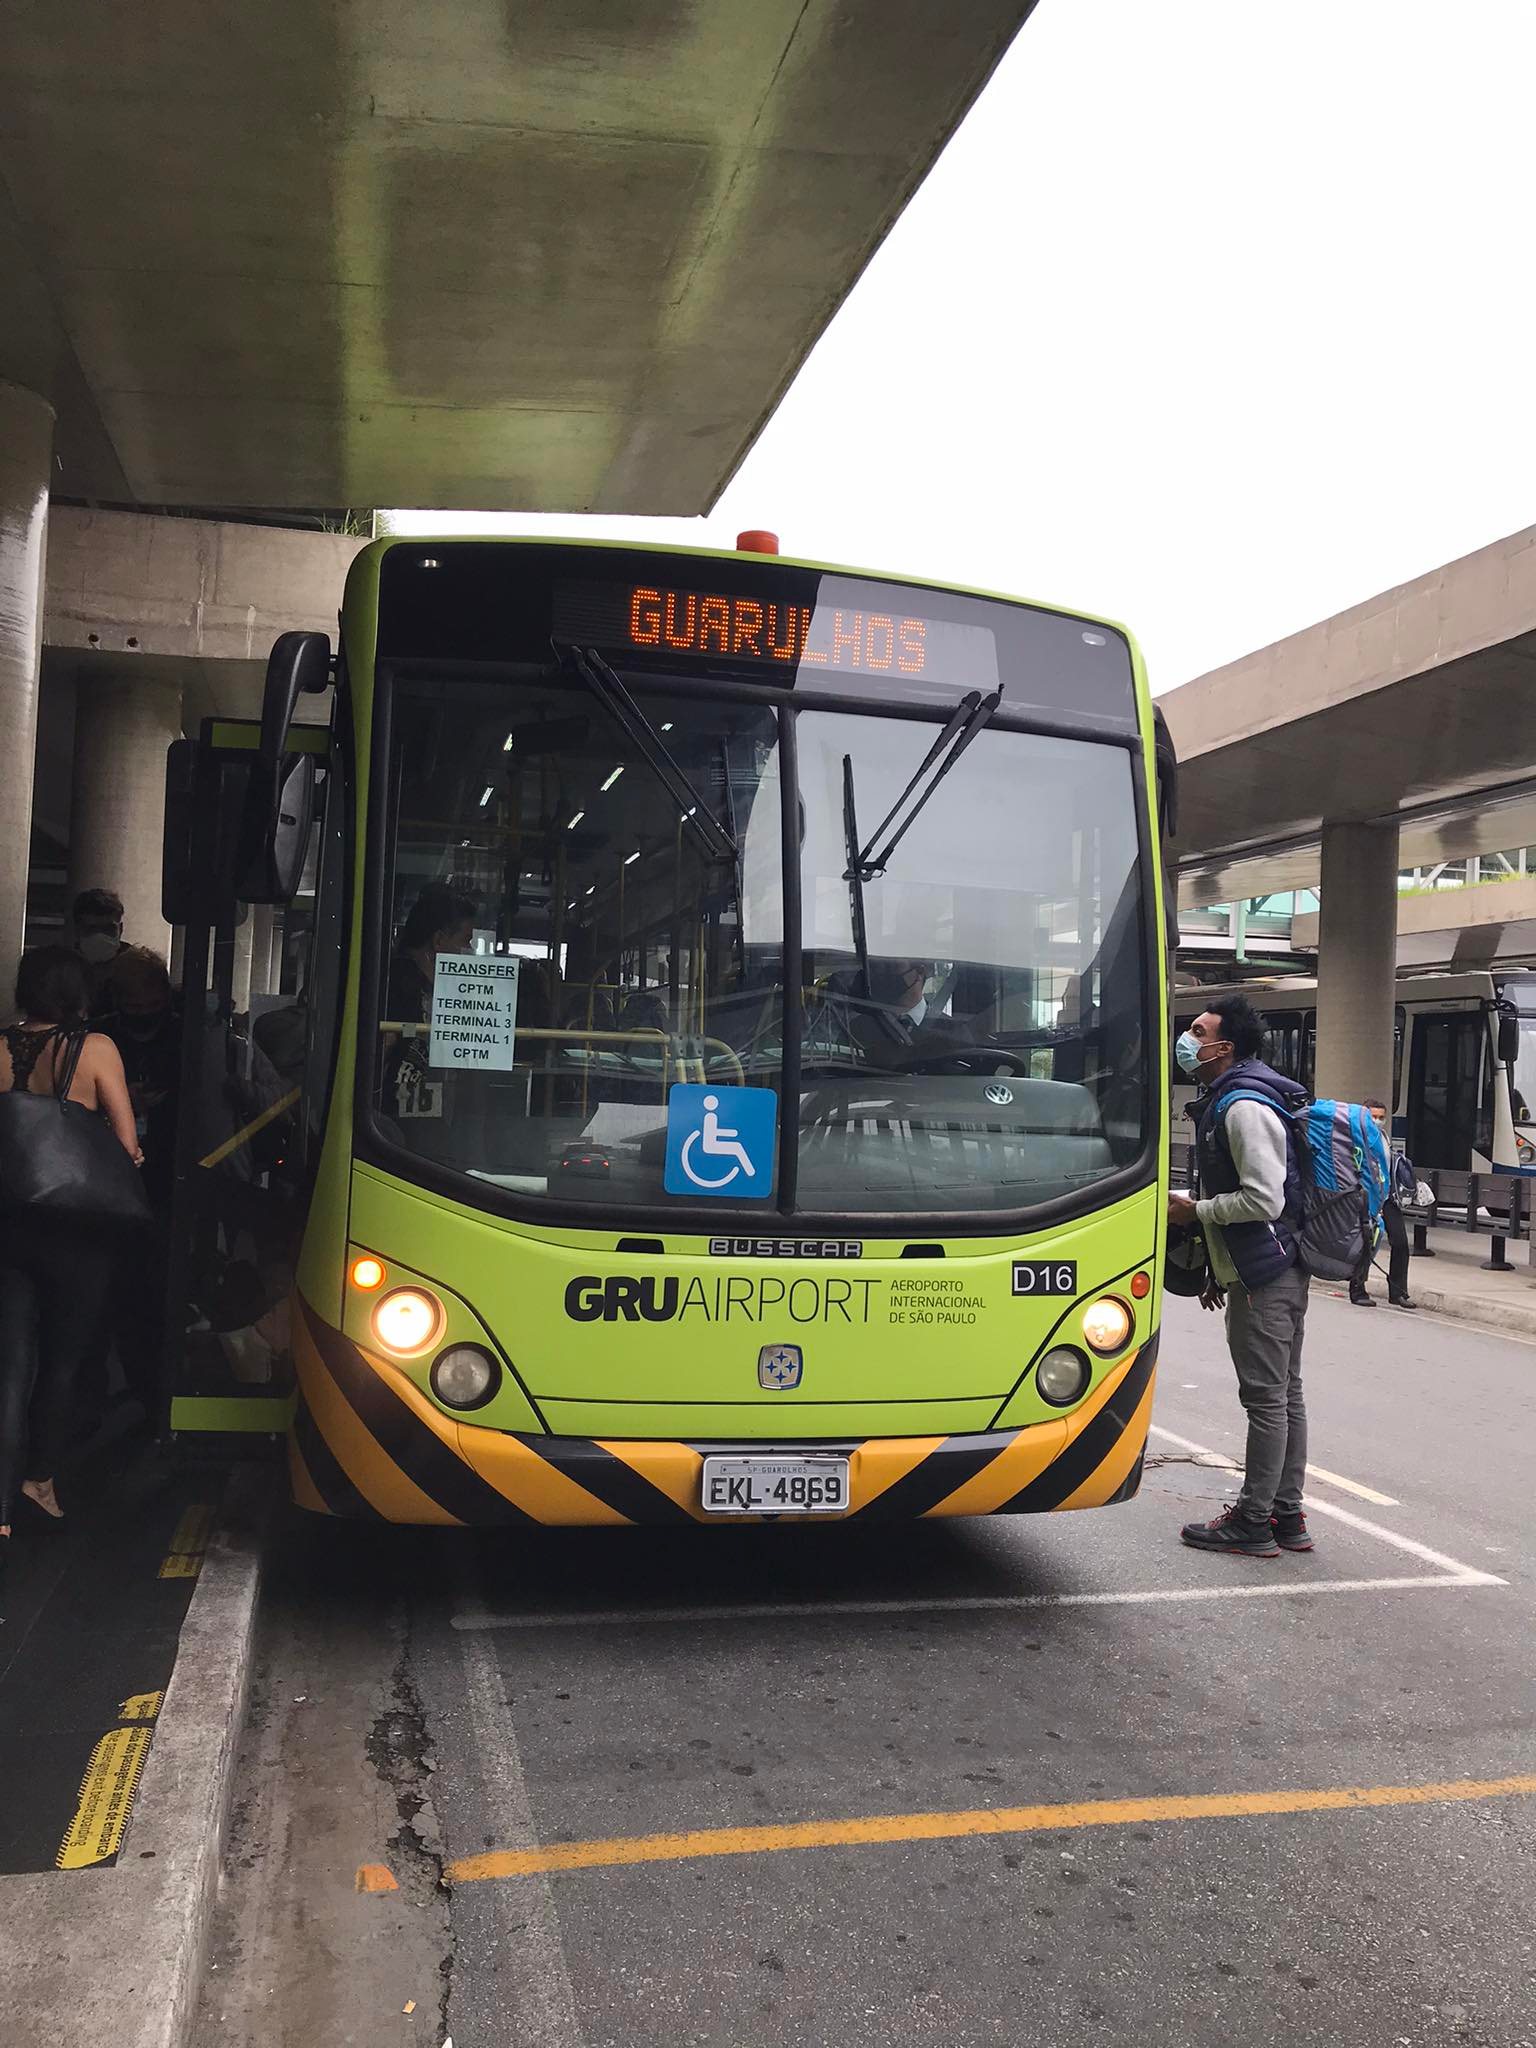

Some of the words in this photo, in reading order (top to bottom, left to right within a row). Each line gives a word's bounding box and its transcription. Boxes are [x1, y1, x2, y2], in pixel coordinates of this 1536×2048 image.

[631, 588, 927, 672] GUARULHOS
[439, 961, 515, 977] TRANSFER
[458, 983, 494, 995] CPTM
[436, 998, 501, 1012] TERMINAL
[506, 1002, 512, 1012] 1
[436, 1014, 500, 1028] TERMINAL
[504, 1018, 512, 1028] 3
[434, 1031, 499, 1044] TERMINAL
[504, 1035, 510, 1044] 1
[453, 1048, 489, 1059] CPTM
[710, 1238, 862, 1257] BUSSCAR
[1013, 1266, 1073, 1291] D16
[890, 1280, 964, 1292] AEROPORTO
[890, 1296, 986, 1308] INTERNACIONAL
[889, 1312, 906, 1323] DE
[909, 1310, 933, 1324] SÃO
[937, 1312, 976, 1324] PAULO
[114, 1754, 133, 1791] passageiros
[109, 1792, 124, 1811] antes
[105, 1812, 121, 1821] de
[70, 1813, 97, 1846] boarding
[96, 1822, 116, 1856] embarcar
